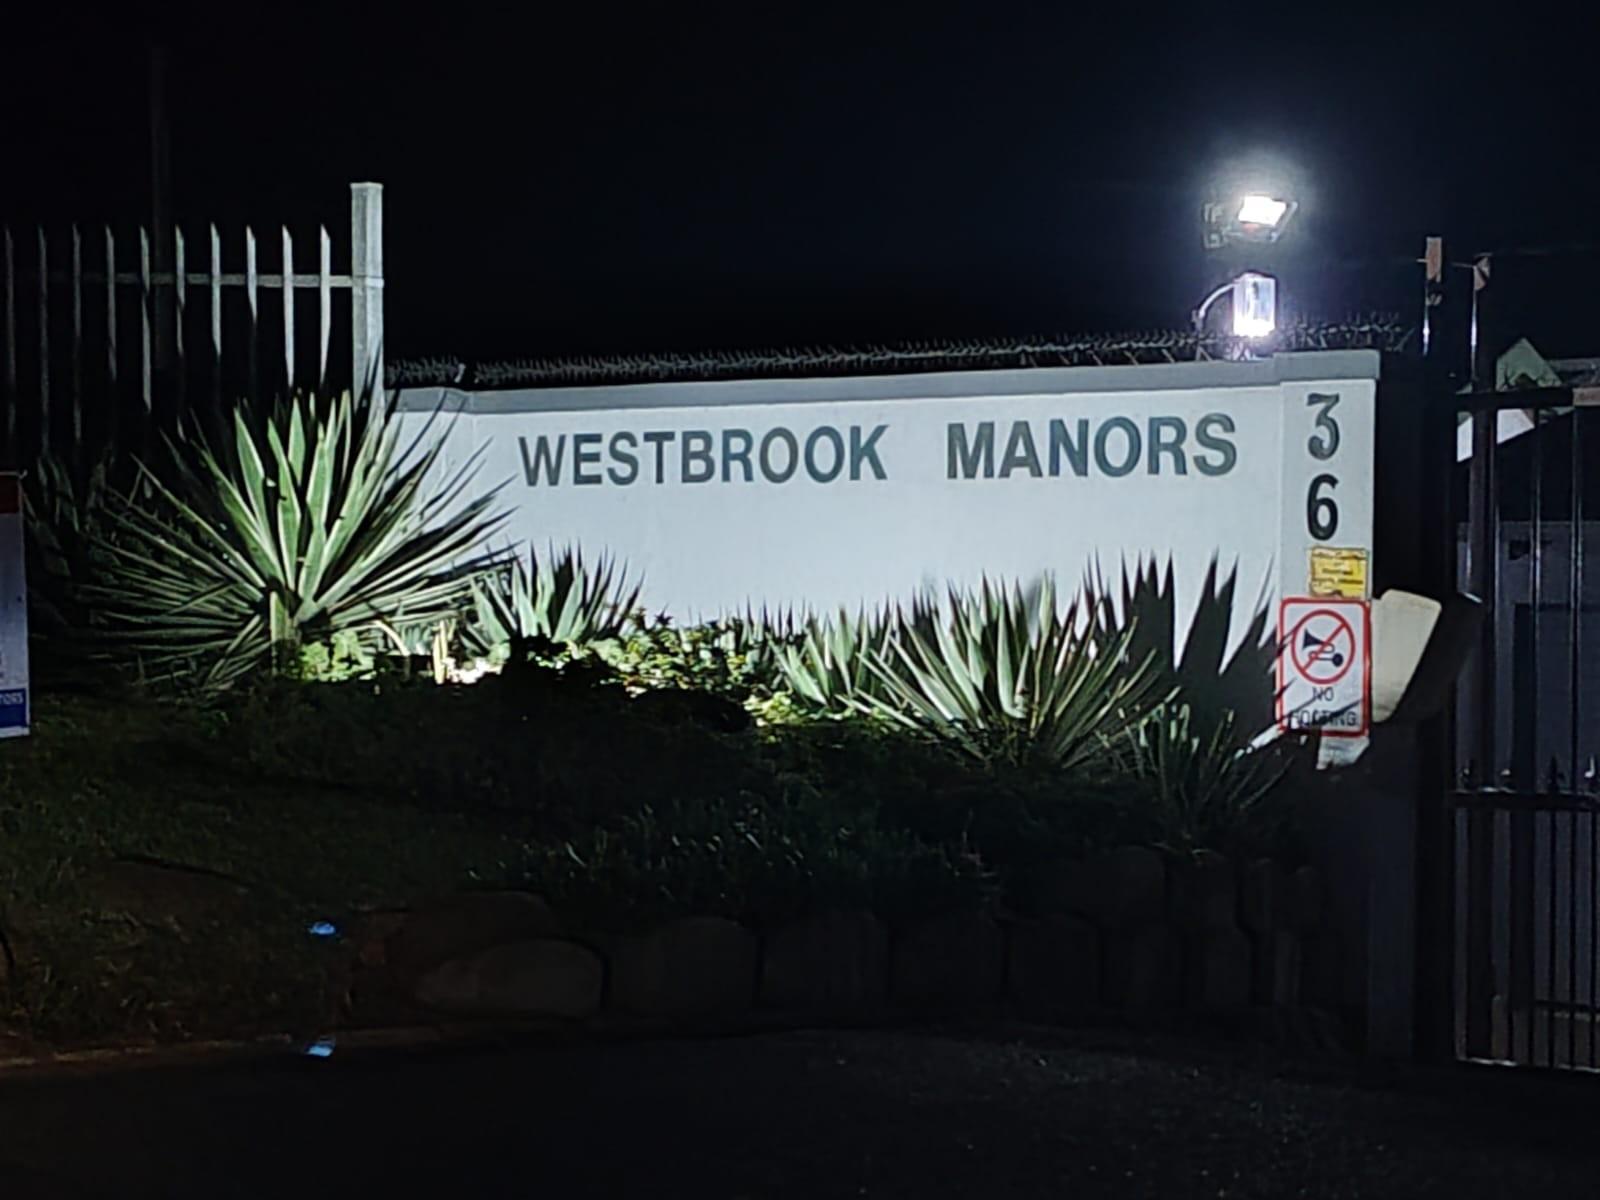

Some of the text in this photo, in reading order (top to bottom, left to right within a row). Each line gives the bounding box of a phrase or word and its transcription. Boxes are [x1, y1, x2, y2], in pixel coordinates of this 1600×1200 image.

[518, 412, 1239, 488] WESTBROOK MANORS
[1311, 685, 1335, 702] NO
